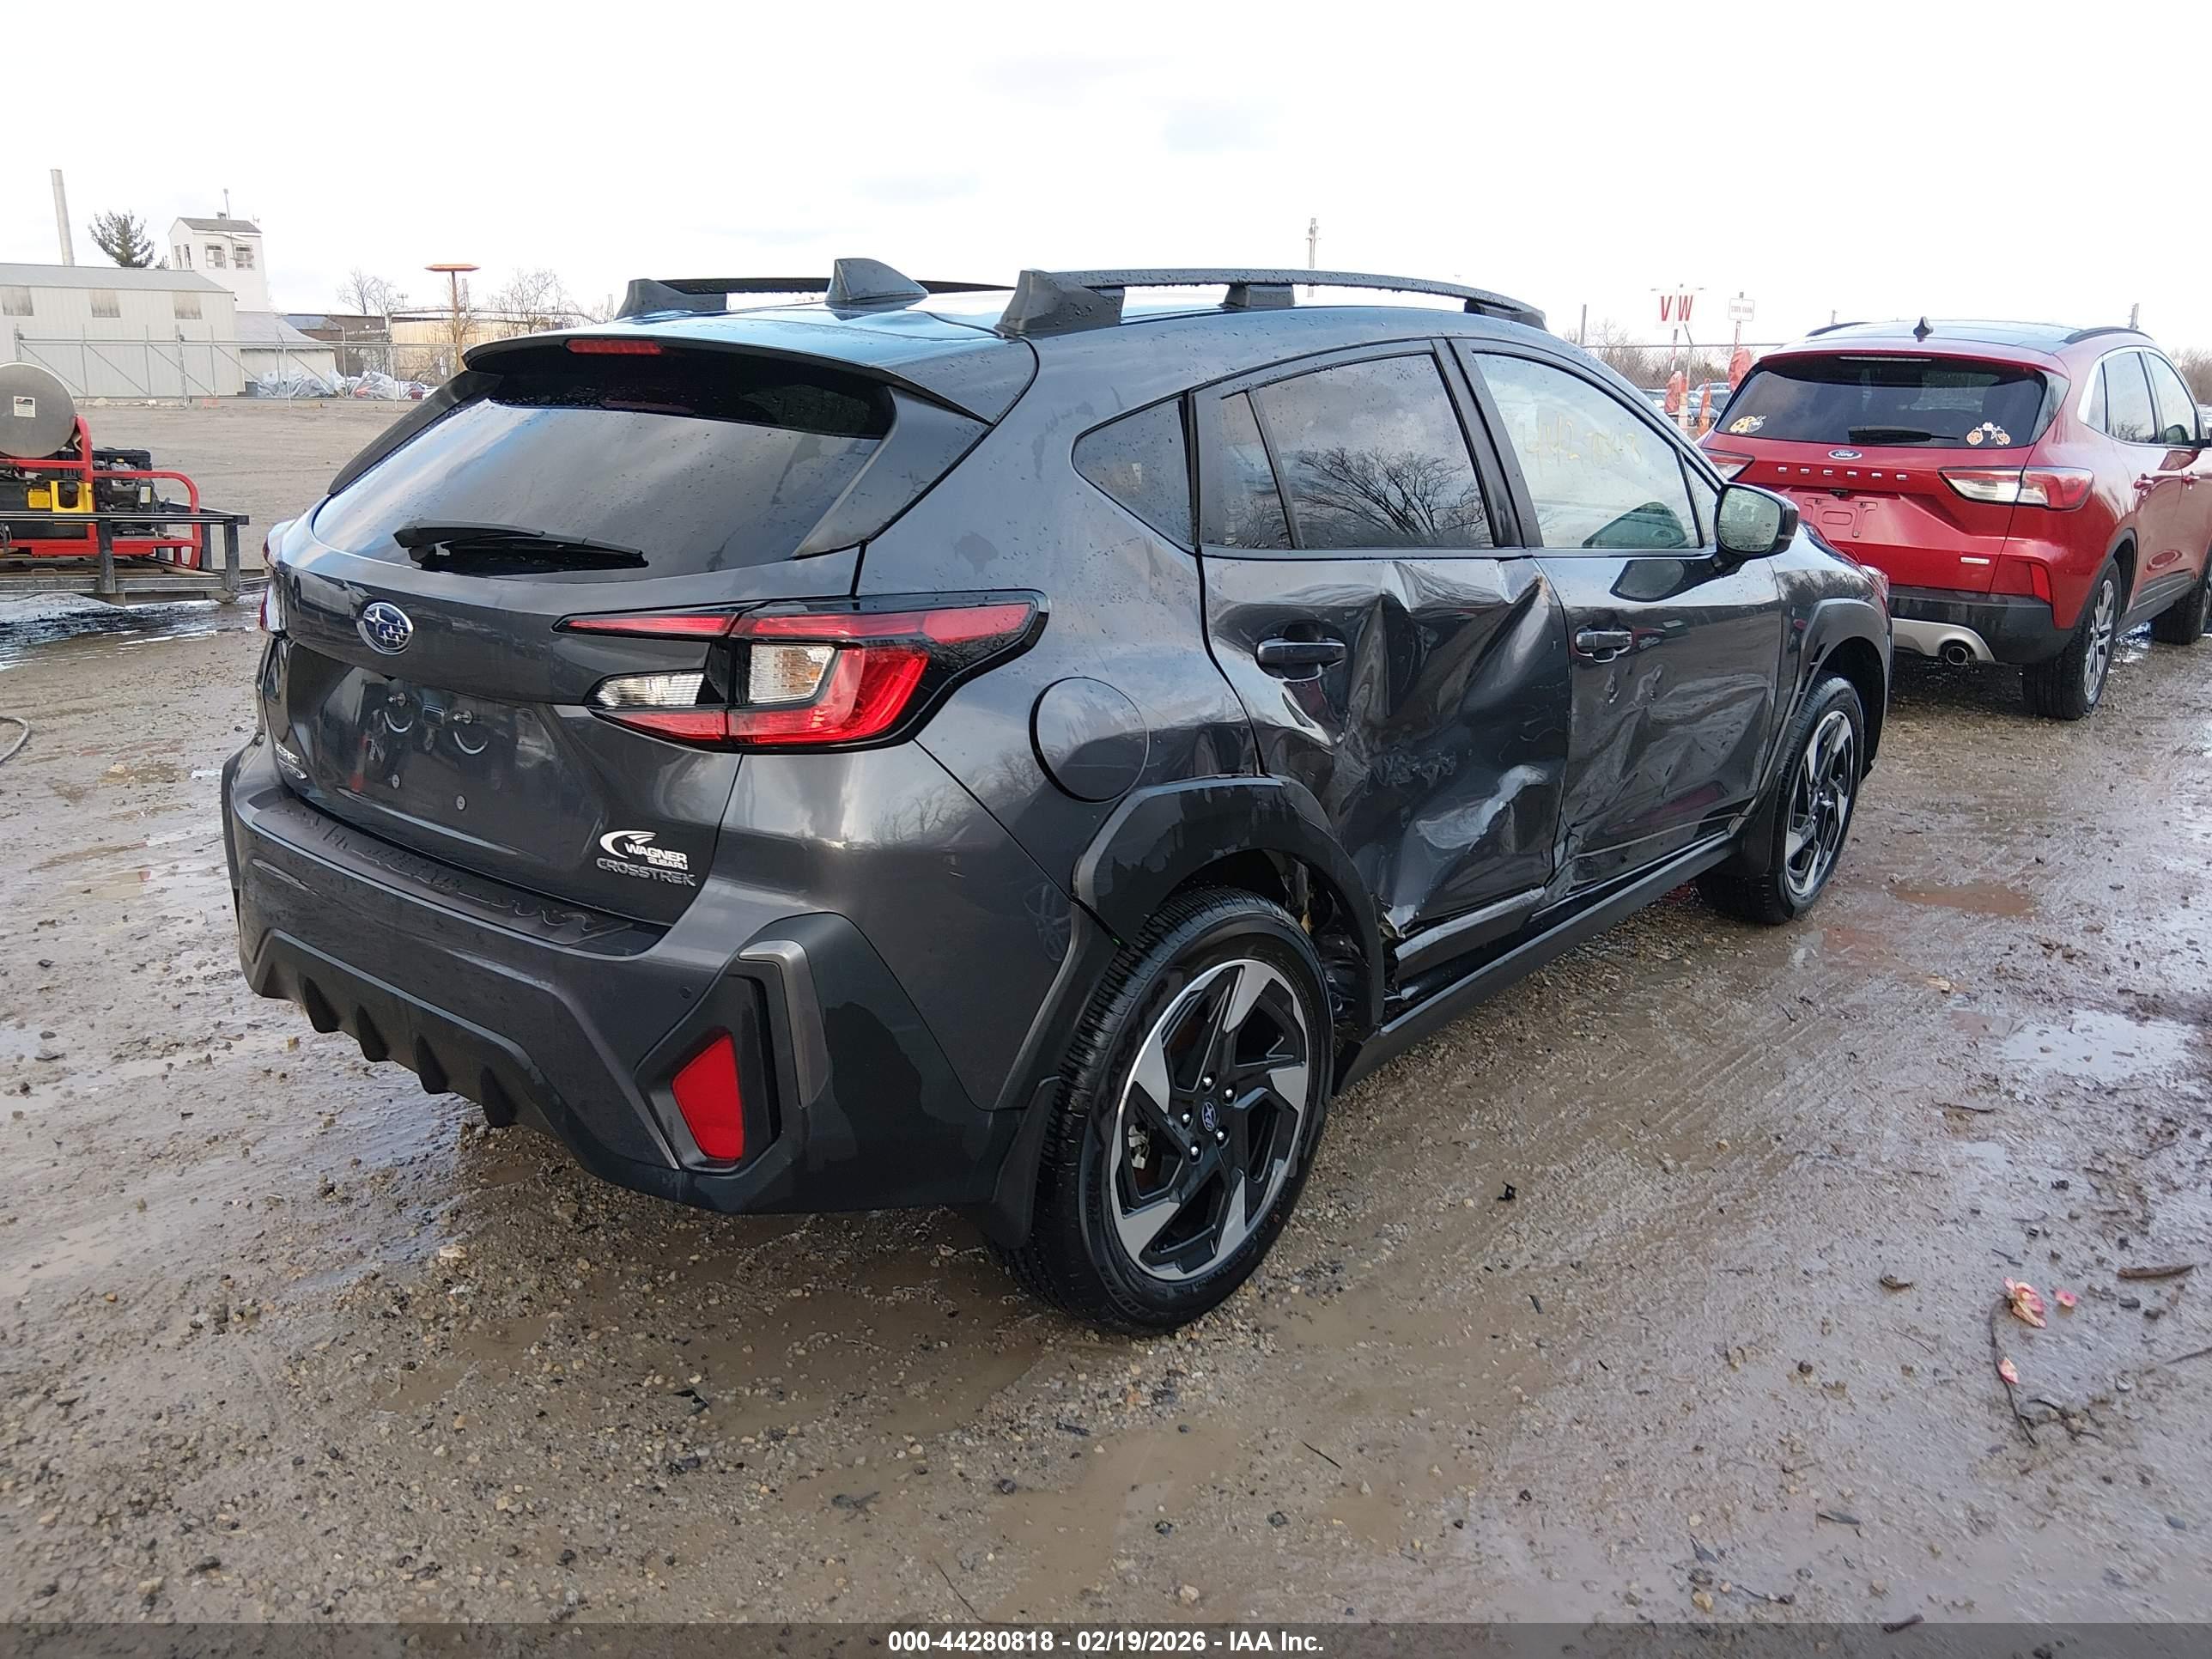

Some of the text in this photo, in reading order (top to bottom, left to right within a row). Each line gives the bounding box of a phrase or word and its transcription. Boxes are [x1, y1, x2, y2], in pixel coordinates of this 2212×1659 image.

[624, 842, 688, 864] WAGNER
[647, 856, 689, 871] SUBARU
[596, 857, 696, 887] CROSSTREK
